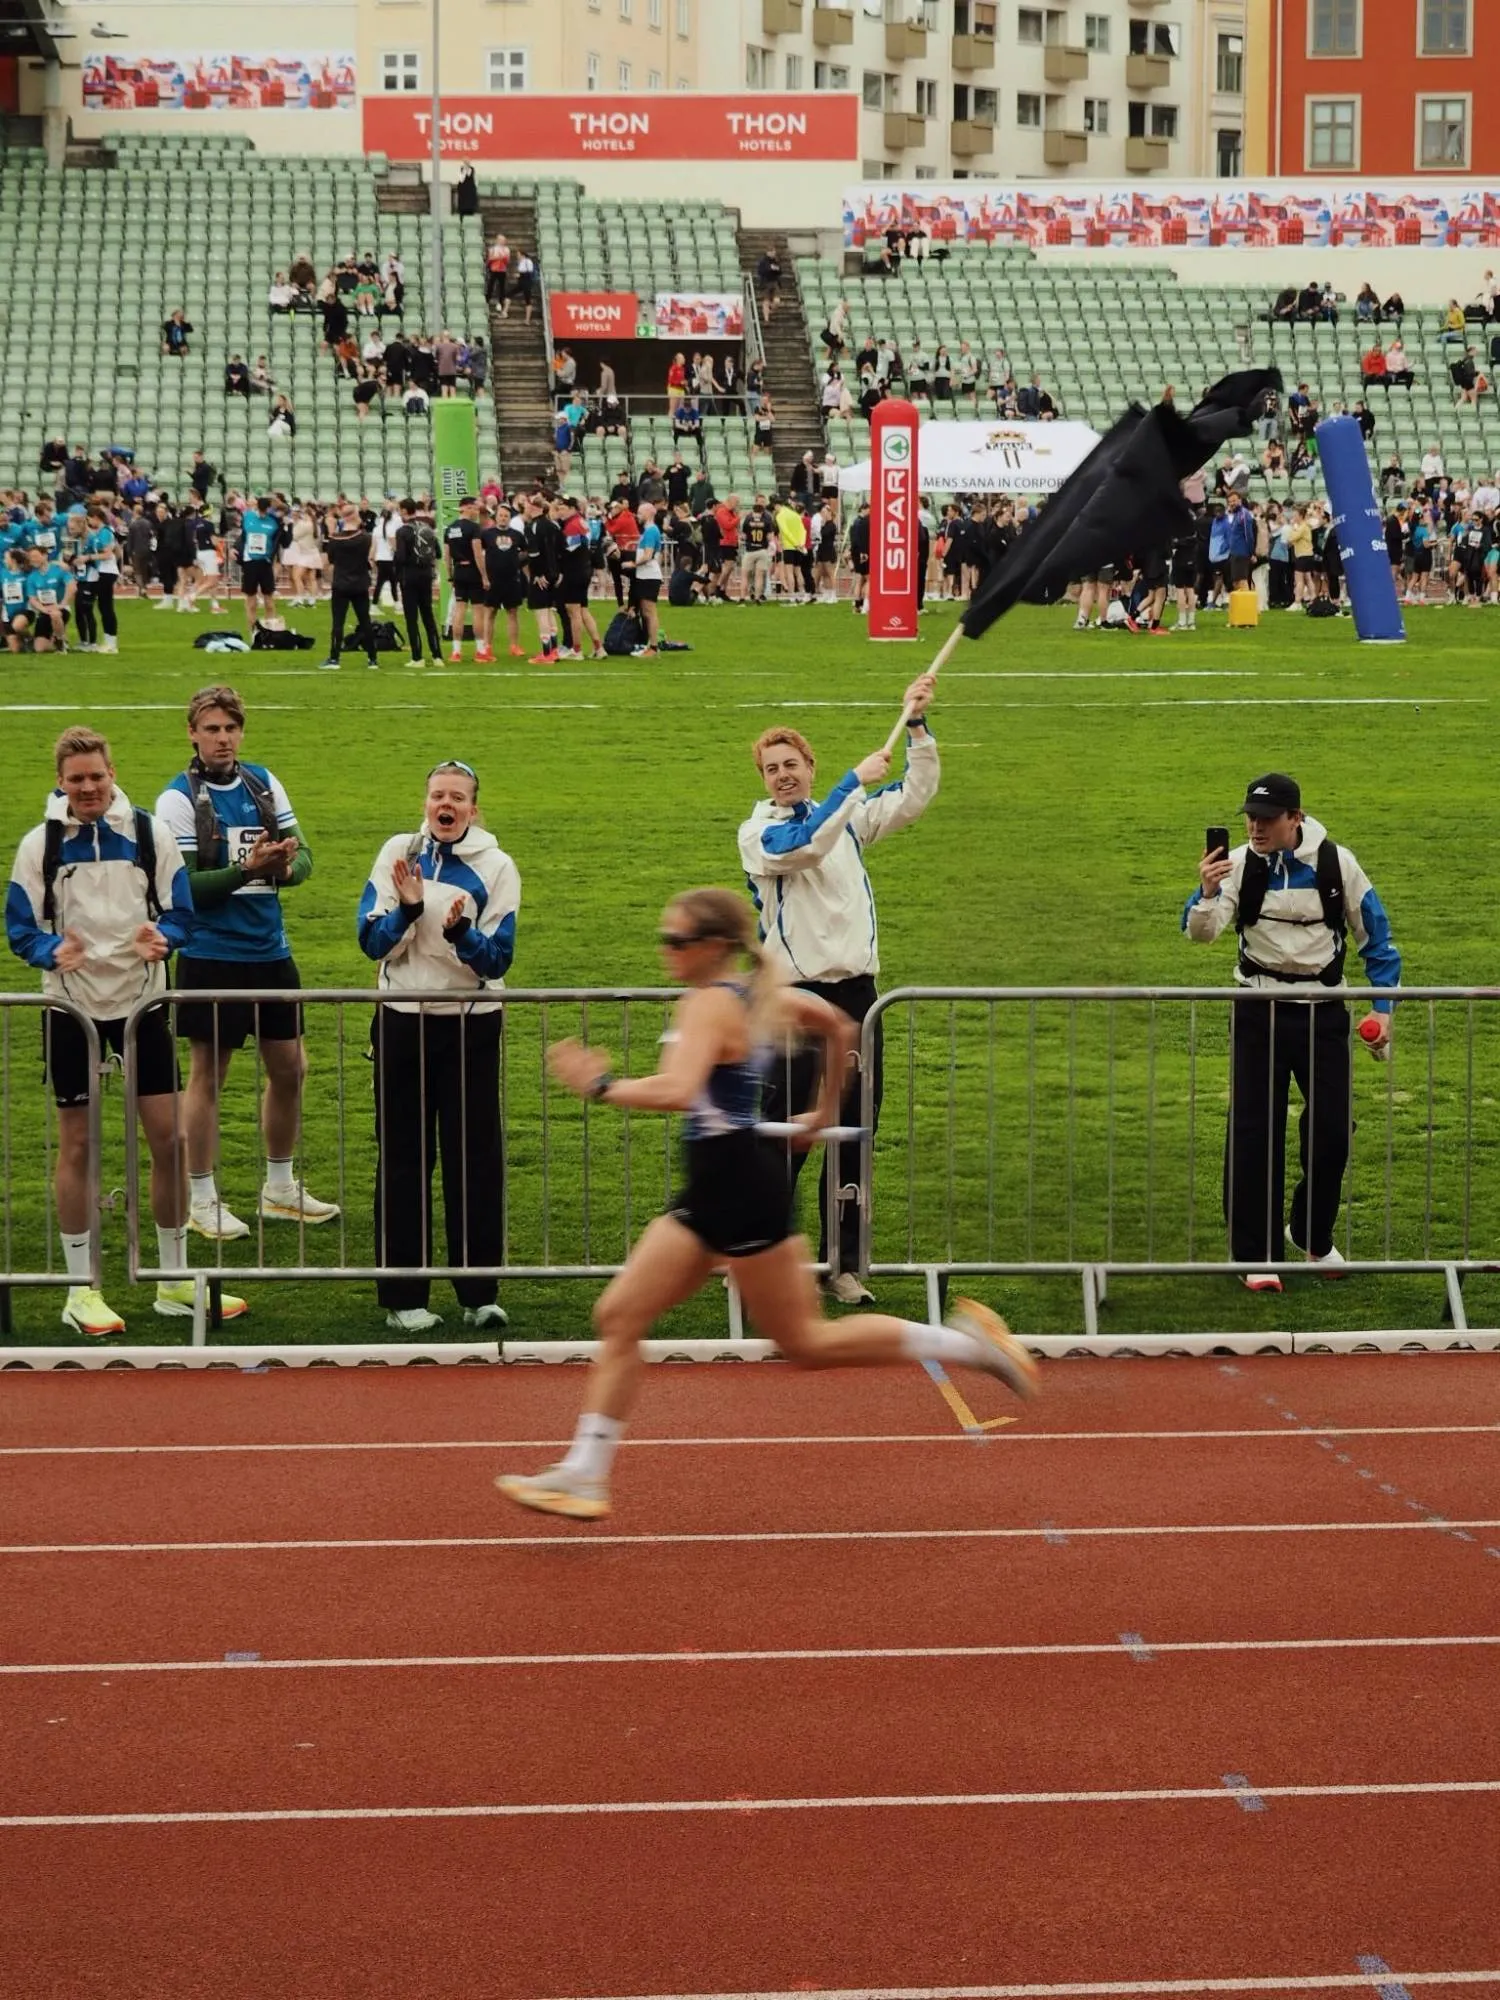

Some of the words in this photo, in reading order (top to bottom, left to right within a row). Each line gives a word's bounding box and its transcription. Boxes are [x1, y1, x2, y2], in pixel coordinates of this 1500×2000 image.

[413, 112, 493, 134] THON
[569, 112, 649, 134] THON
[726, 112, 807, 134] THON
[583, 139, 635, 151] HOTELS
[739, 139, 792, 151] HOTELS
[566, 304, 621, 320] THON
[575, 323, 611, 332] HOTELS
[456, 470, 468, 495] pris
[923, 476, 958, 488] MENS
[960, 476, 995, 488] SANA
[998, 476, 1011, 488] IN
[887, 470, 905, 570] SPAR
